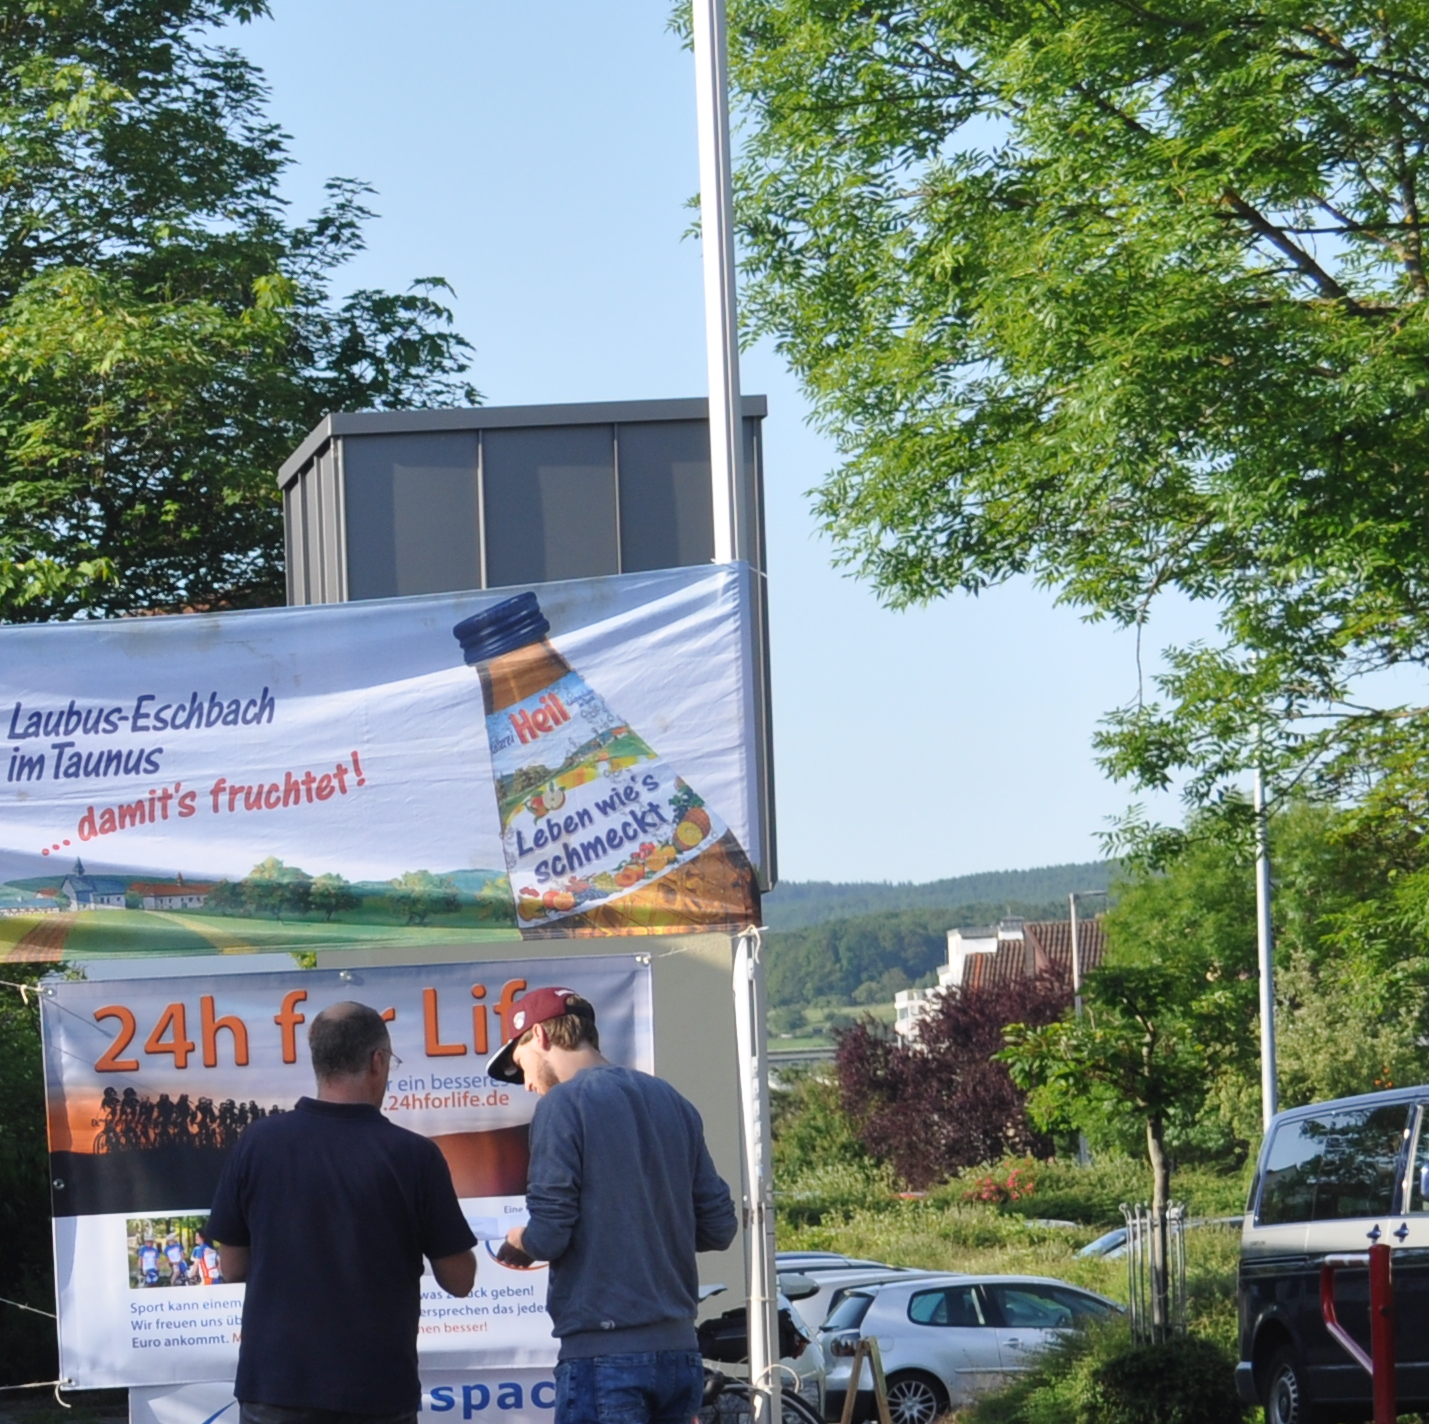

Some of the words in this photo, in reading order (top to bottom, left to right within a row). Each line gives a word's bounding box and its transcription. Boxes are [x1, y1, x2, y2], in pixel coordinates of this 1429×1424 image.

[6, 686, 276, 741] Laubus-Eschbach
[509, 692, 571, 745] Heil
[6, 746, 45, 783] im
[48, 741, 164, 781] Taunus
[210, 751, 368, 815] fruchtet!
[516, 806, 594, 858] Leben
[595, 773, 660, 818] wie's
[534, 801, 668, 884] schmeckt
[93, 994, 250, 1073] 24h
[398, 1075, 425, 1091] ein
[130, 1301, 165, 1316] Sport
[168, 1299, 200, 1312] kann
[202, 1298, 242, 1311] einem
[490, 1285, 534, 1301] geben!
[130, 1318, 153, 1331] Wir
[155, 1316, 197, 1330] freuen
[201, 1316, 223, 1328] uns
[420, 1304, 491, 1320] ersprechen
[494, 1303, 514, 1314] das
[132, 1337, 161, 1350] Euro
[164, 1333, 229, 1347] ankommt.
[444, 1321, 488, 1334] besser!
[417, 1380, 554, 1419] spac
